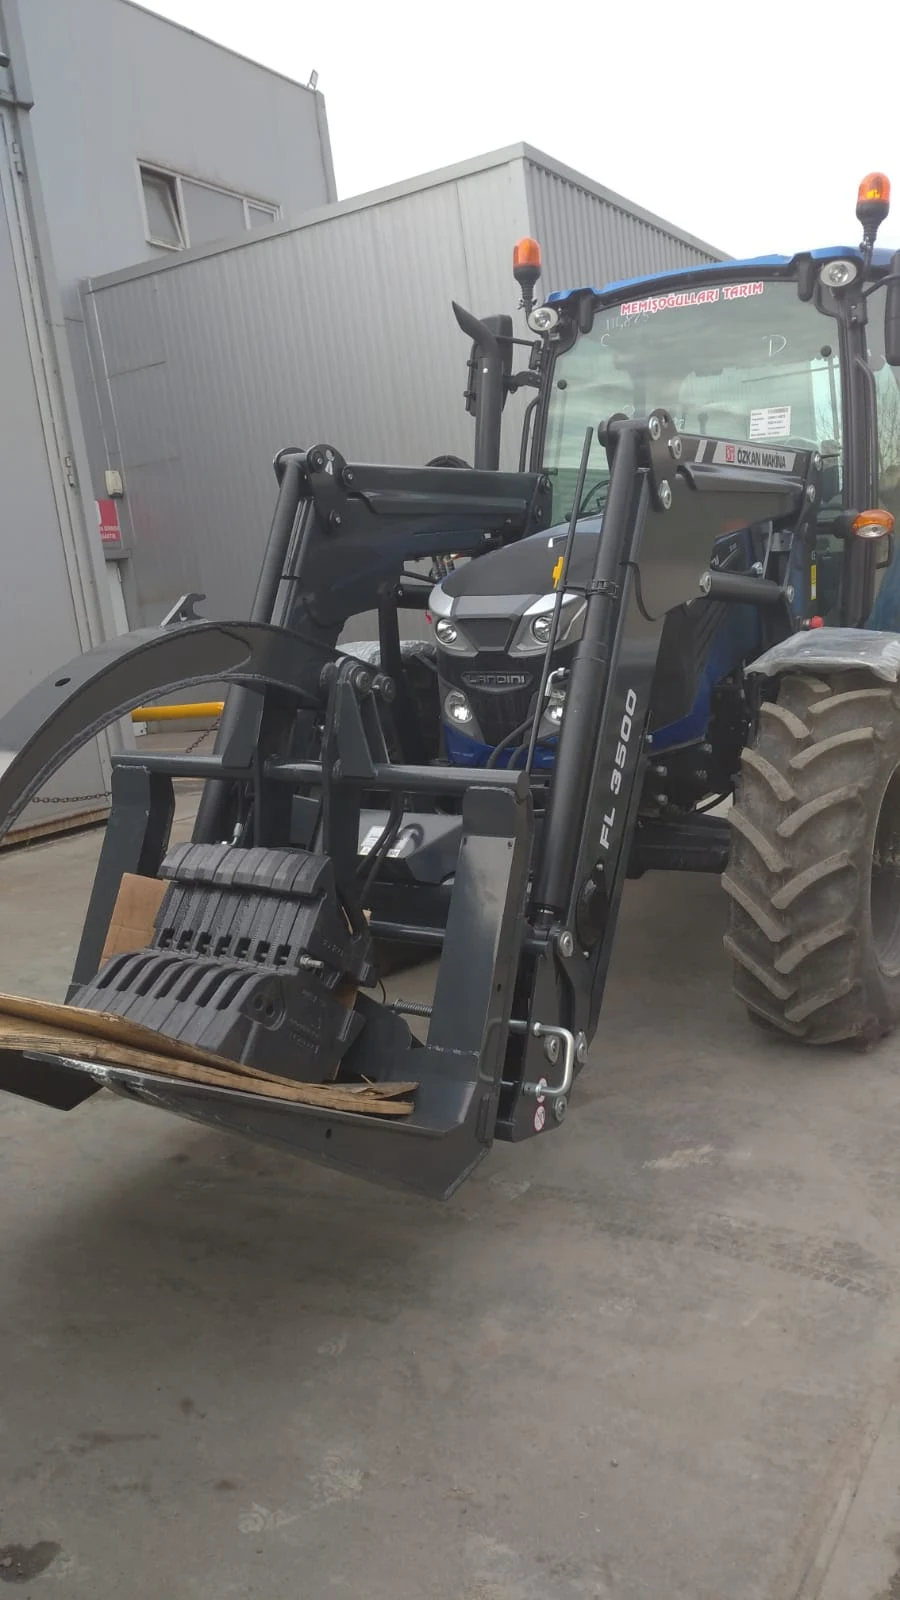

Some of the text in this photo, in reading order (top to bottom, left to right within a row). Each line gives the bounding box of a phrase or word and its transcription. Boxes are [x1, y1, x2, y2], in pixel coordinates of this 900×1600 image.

[722, 281, 763, 300] TARIM
[600, 688, 637, 850] FL 3500
